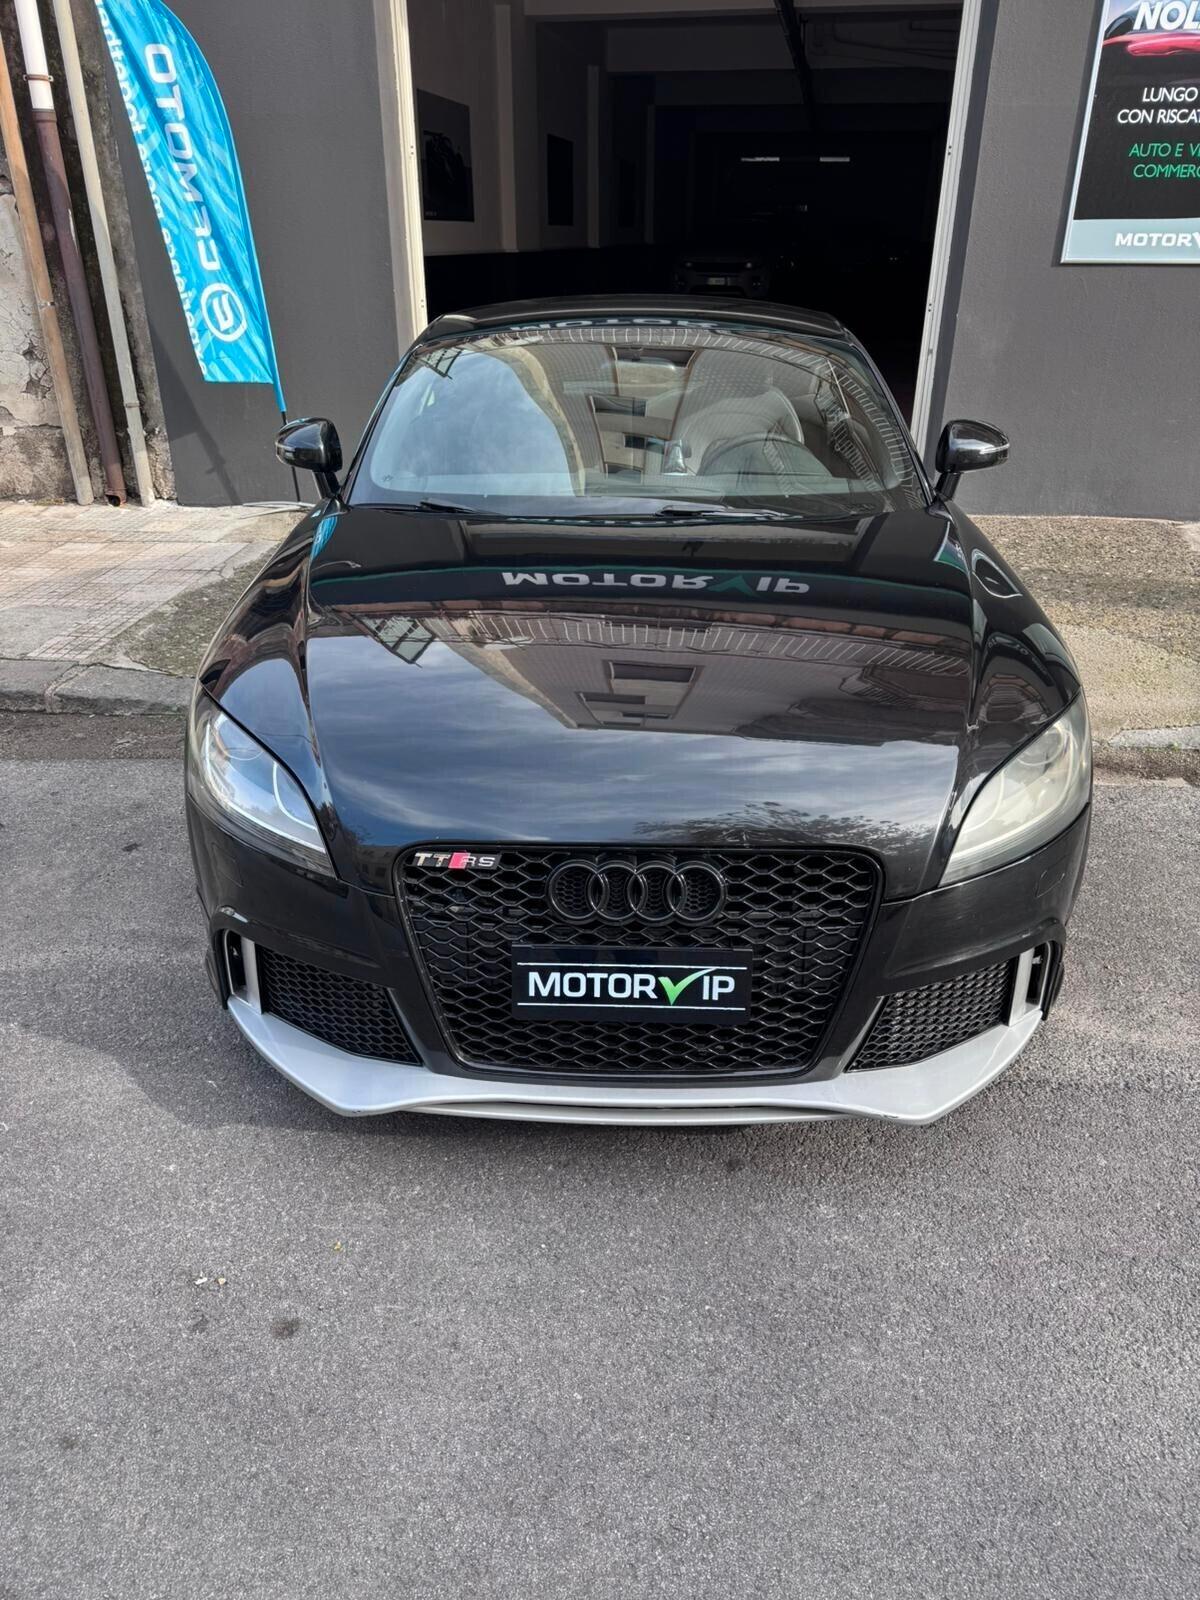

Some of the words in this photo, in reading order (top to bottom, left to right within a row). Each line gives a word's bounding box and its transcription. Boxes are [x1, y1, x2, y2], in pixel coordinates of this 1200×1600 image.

[1133, 0, 1200, 30] NOL
[1142, 86, 1199, 102] LUNGO
[1117, 108, 1154, 124] CON
[1128, 143, 1172, 157] AUTO
[1174, 143, 1185, 157] E
[1189, 143, 1200, 157] V
